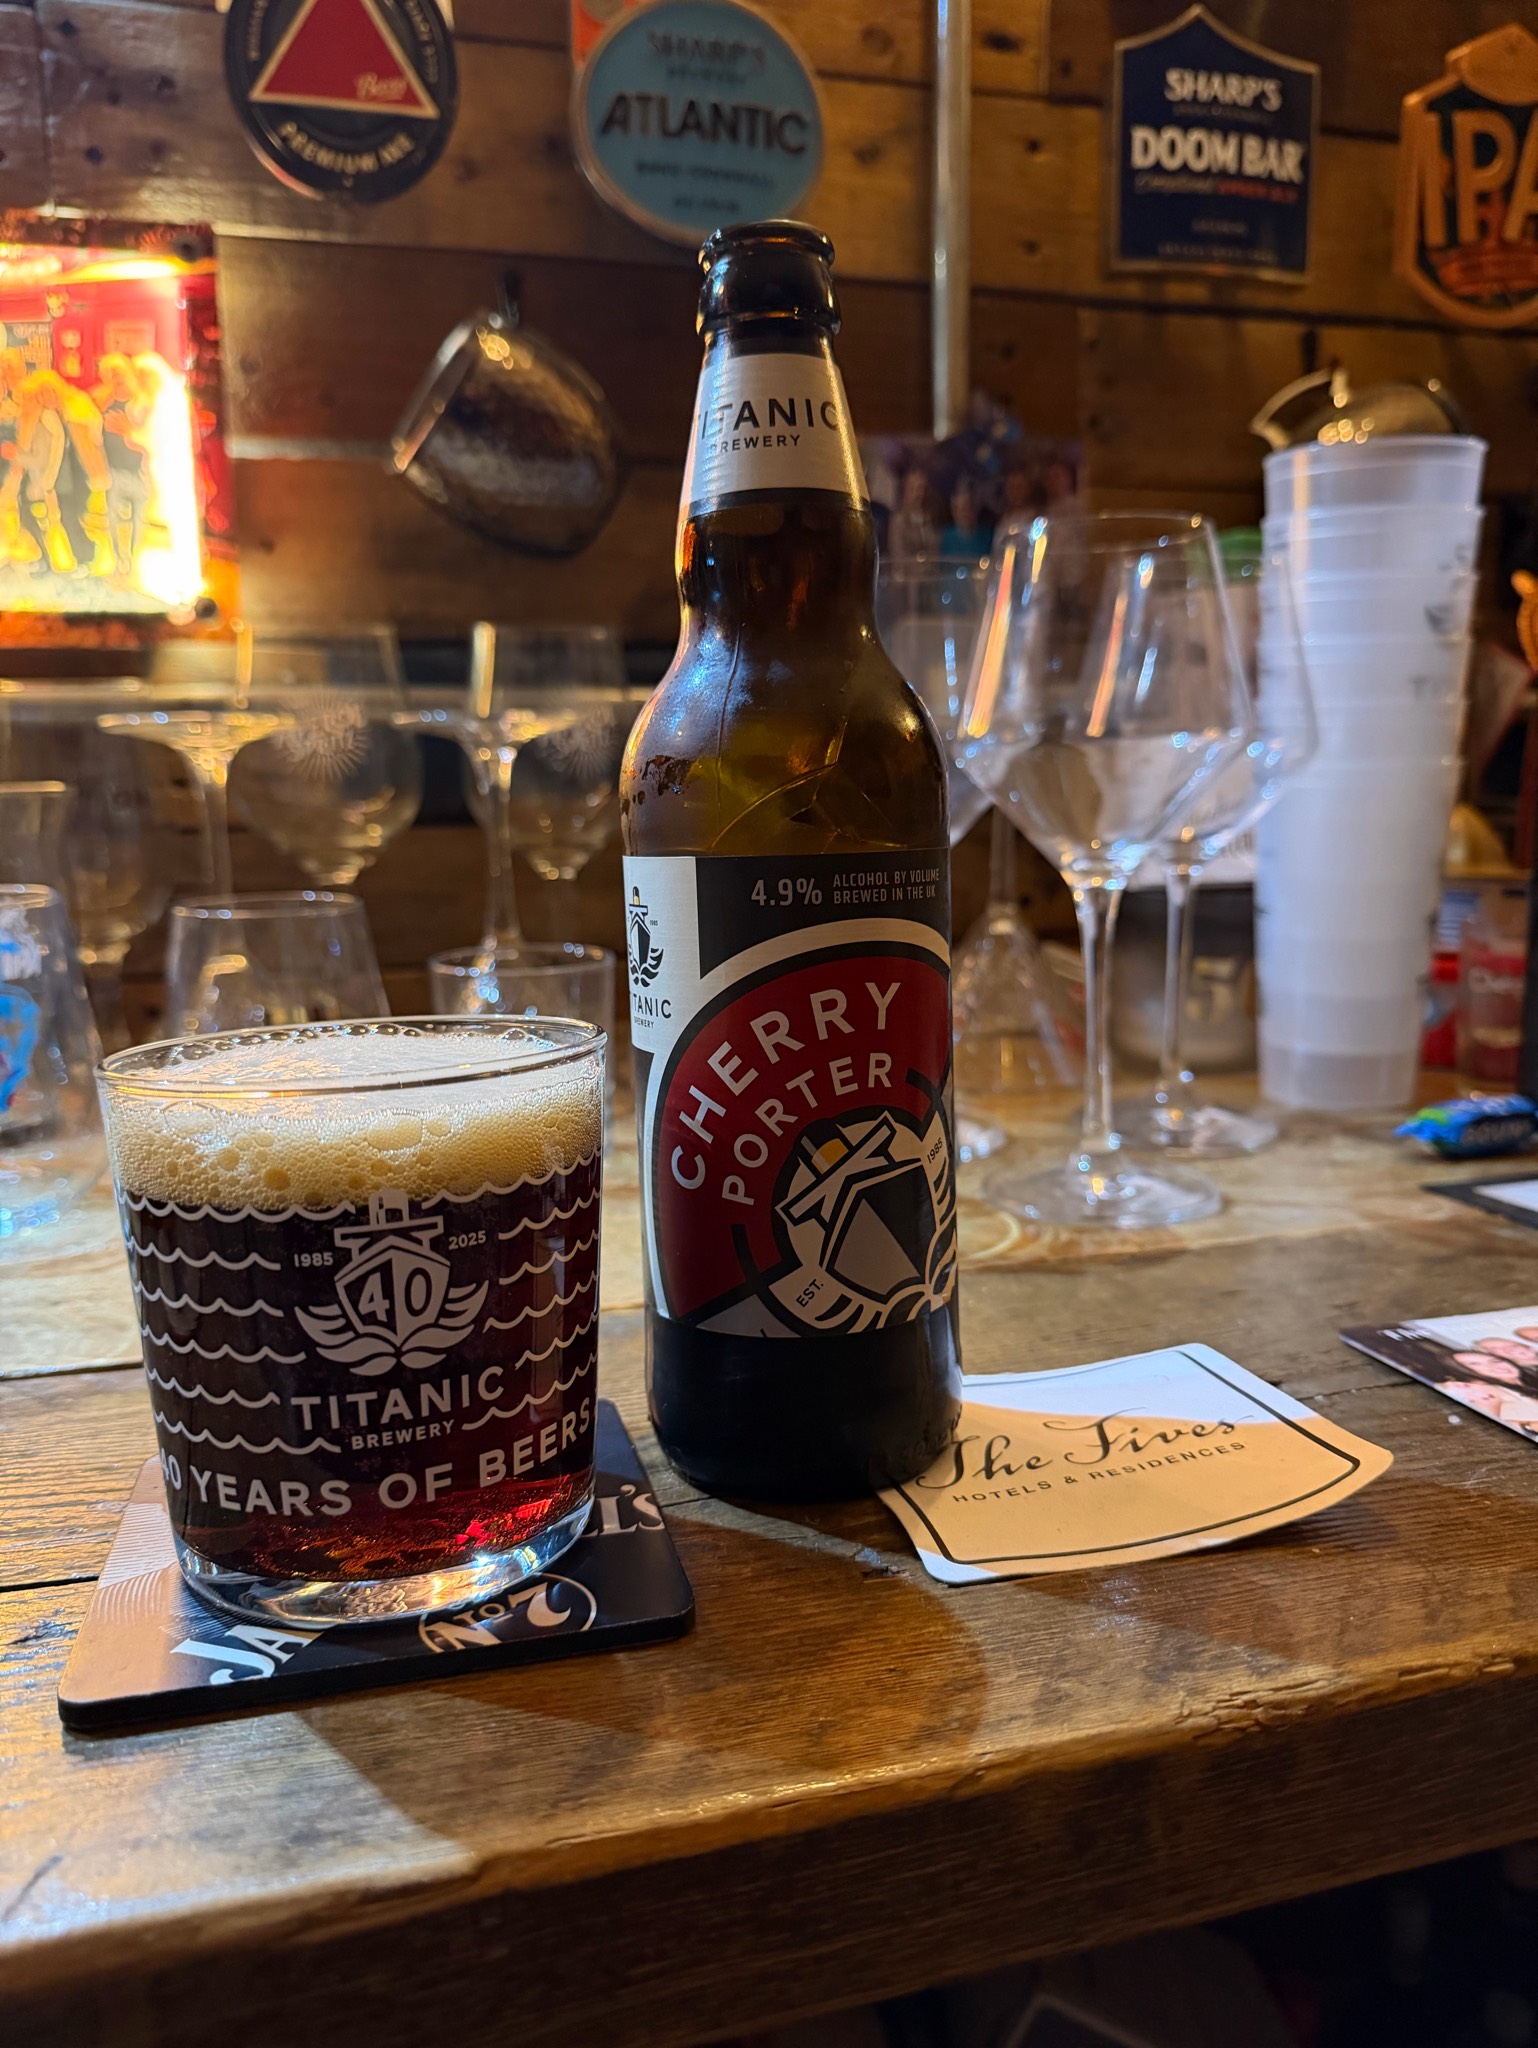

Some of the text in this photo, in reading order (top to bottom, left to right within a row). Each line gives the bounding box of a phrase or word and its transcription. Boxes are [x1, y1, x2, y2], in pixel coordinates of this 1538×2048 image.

[1164, 67, 1283, 112] SHARP'S
[600, 93, 807, 155] ATLANTIC
[1131, 124, 1305, 184] DOOM BAR
[698, 397, 842, 440] ITANIC
[751, 878, 823, 906] 4.9%
[833, 868, 940, 888] ALCOHOL BY VOLUME
[833, 884, 936, 904] BREWED IN THE UK
[671, 982, 901, 1189] CHERRY
[721, 1052, 892, 1206] PORTER
[927, 1136, 943, 1164] 1985
[294, 1252, 334, 1268] 1985
[448, 1230, 487, 1250] 2025
[358, 1267, 432, 1322] 40
[796, 1279, 824, 1307] EST.
[291, 1366, 504, 1430] TITANIC
[190, 1465, 352, 1517] YEARS
[379, 1462, 452, 1510] OF
[479, 1397, 590, 1486] BEERS
[352, 1419, 455, 1450] BREWERY
[915, 1434, 1053, 1489] The
[1043, 1406, 1254, 1465] Fives
[952, 1441, 1246, 1502] HOTELS & RESIDENCES
[581, 1484, 665, 1538] L'S
[508, 1581, 571, 1627] 7
[170, 1624, 325, 1686] JA
